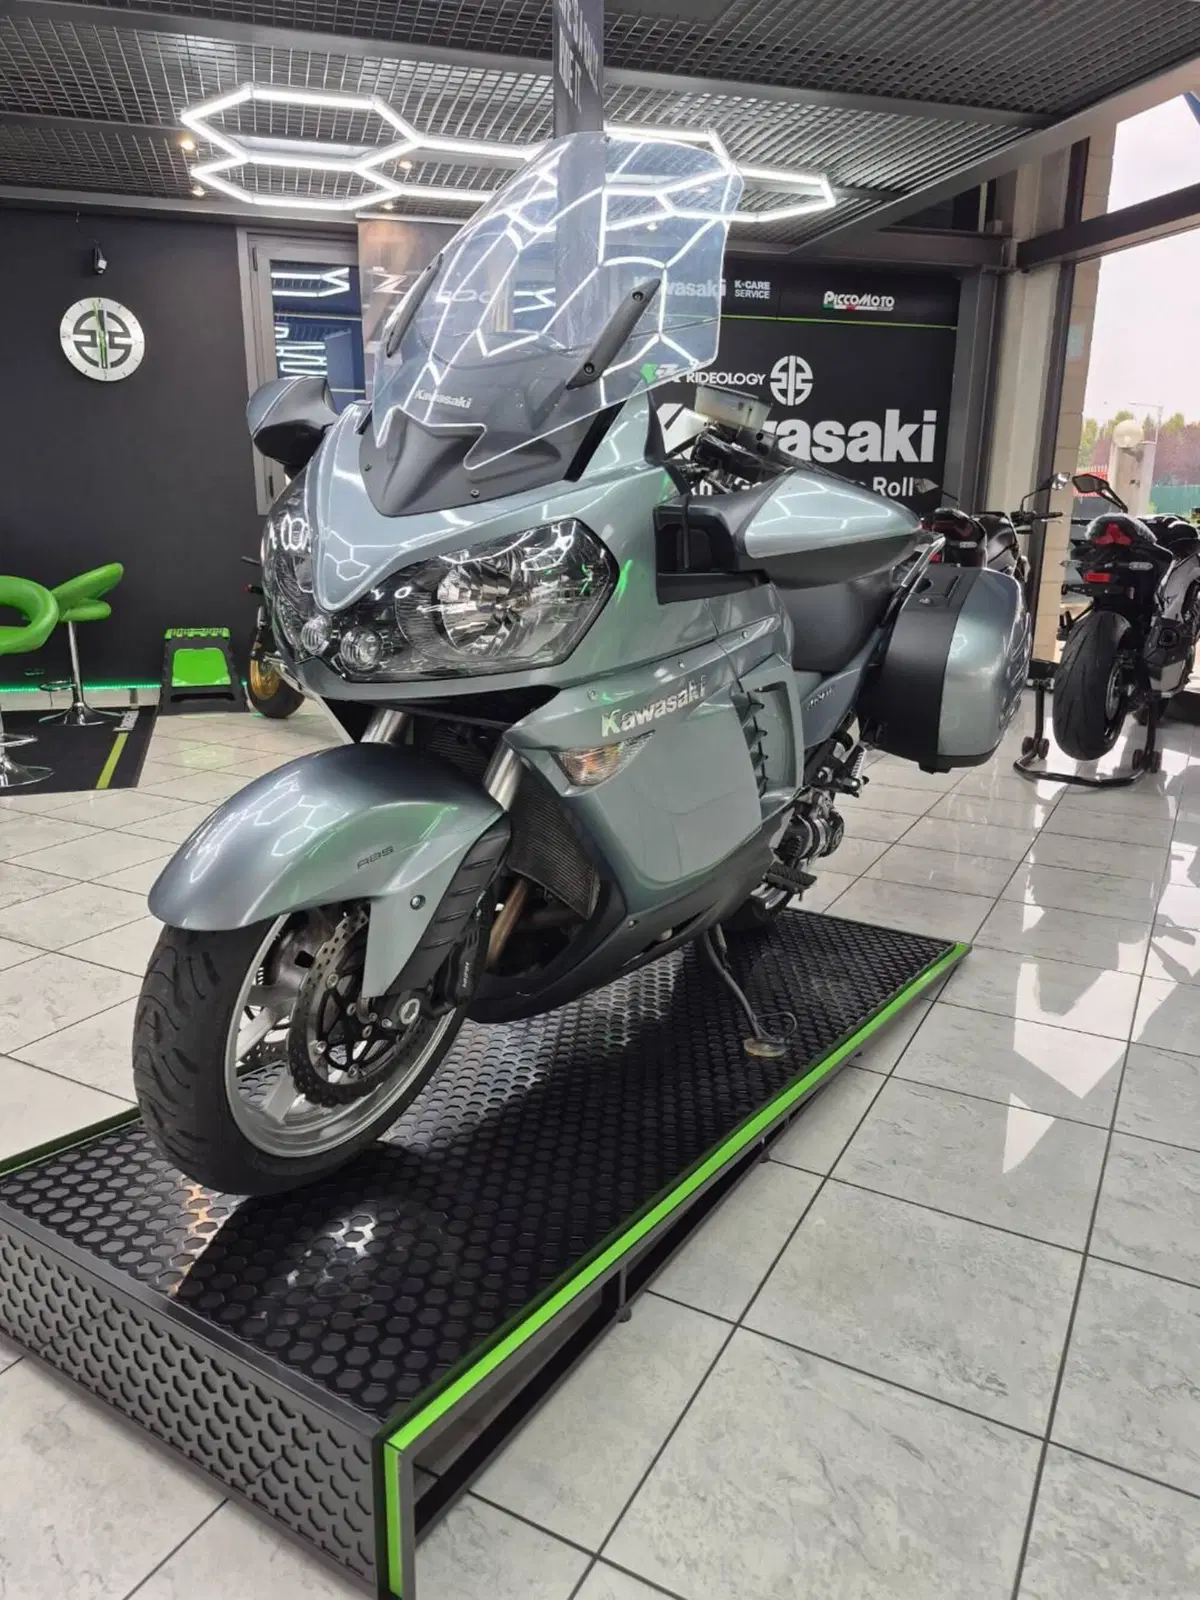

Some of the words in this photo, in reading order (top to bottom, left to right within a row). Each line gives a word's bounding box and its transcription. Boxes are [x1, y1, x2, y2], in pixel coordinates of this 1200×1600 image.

[734, 289, 770, 299] SERVICE
[686, 371, 766, 386] RIDEOLOGY
[655, 402, 938, 463] Kasaki
[872, 476, 914, 497] Roll
[601, 675, 707, 737] Kawasaki
